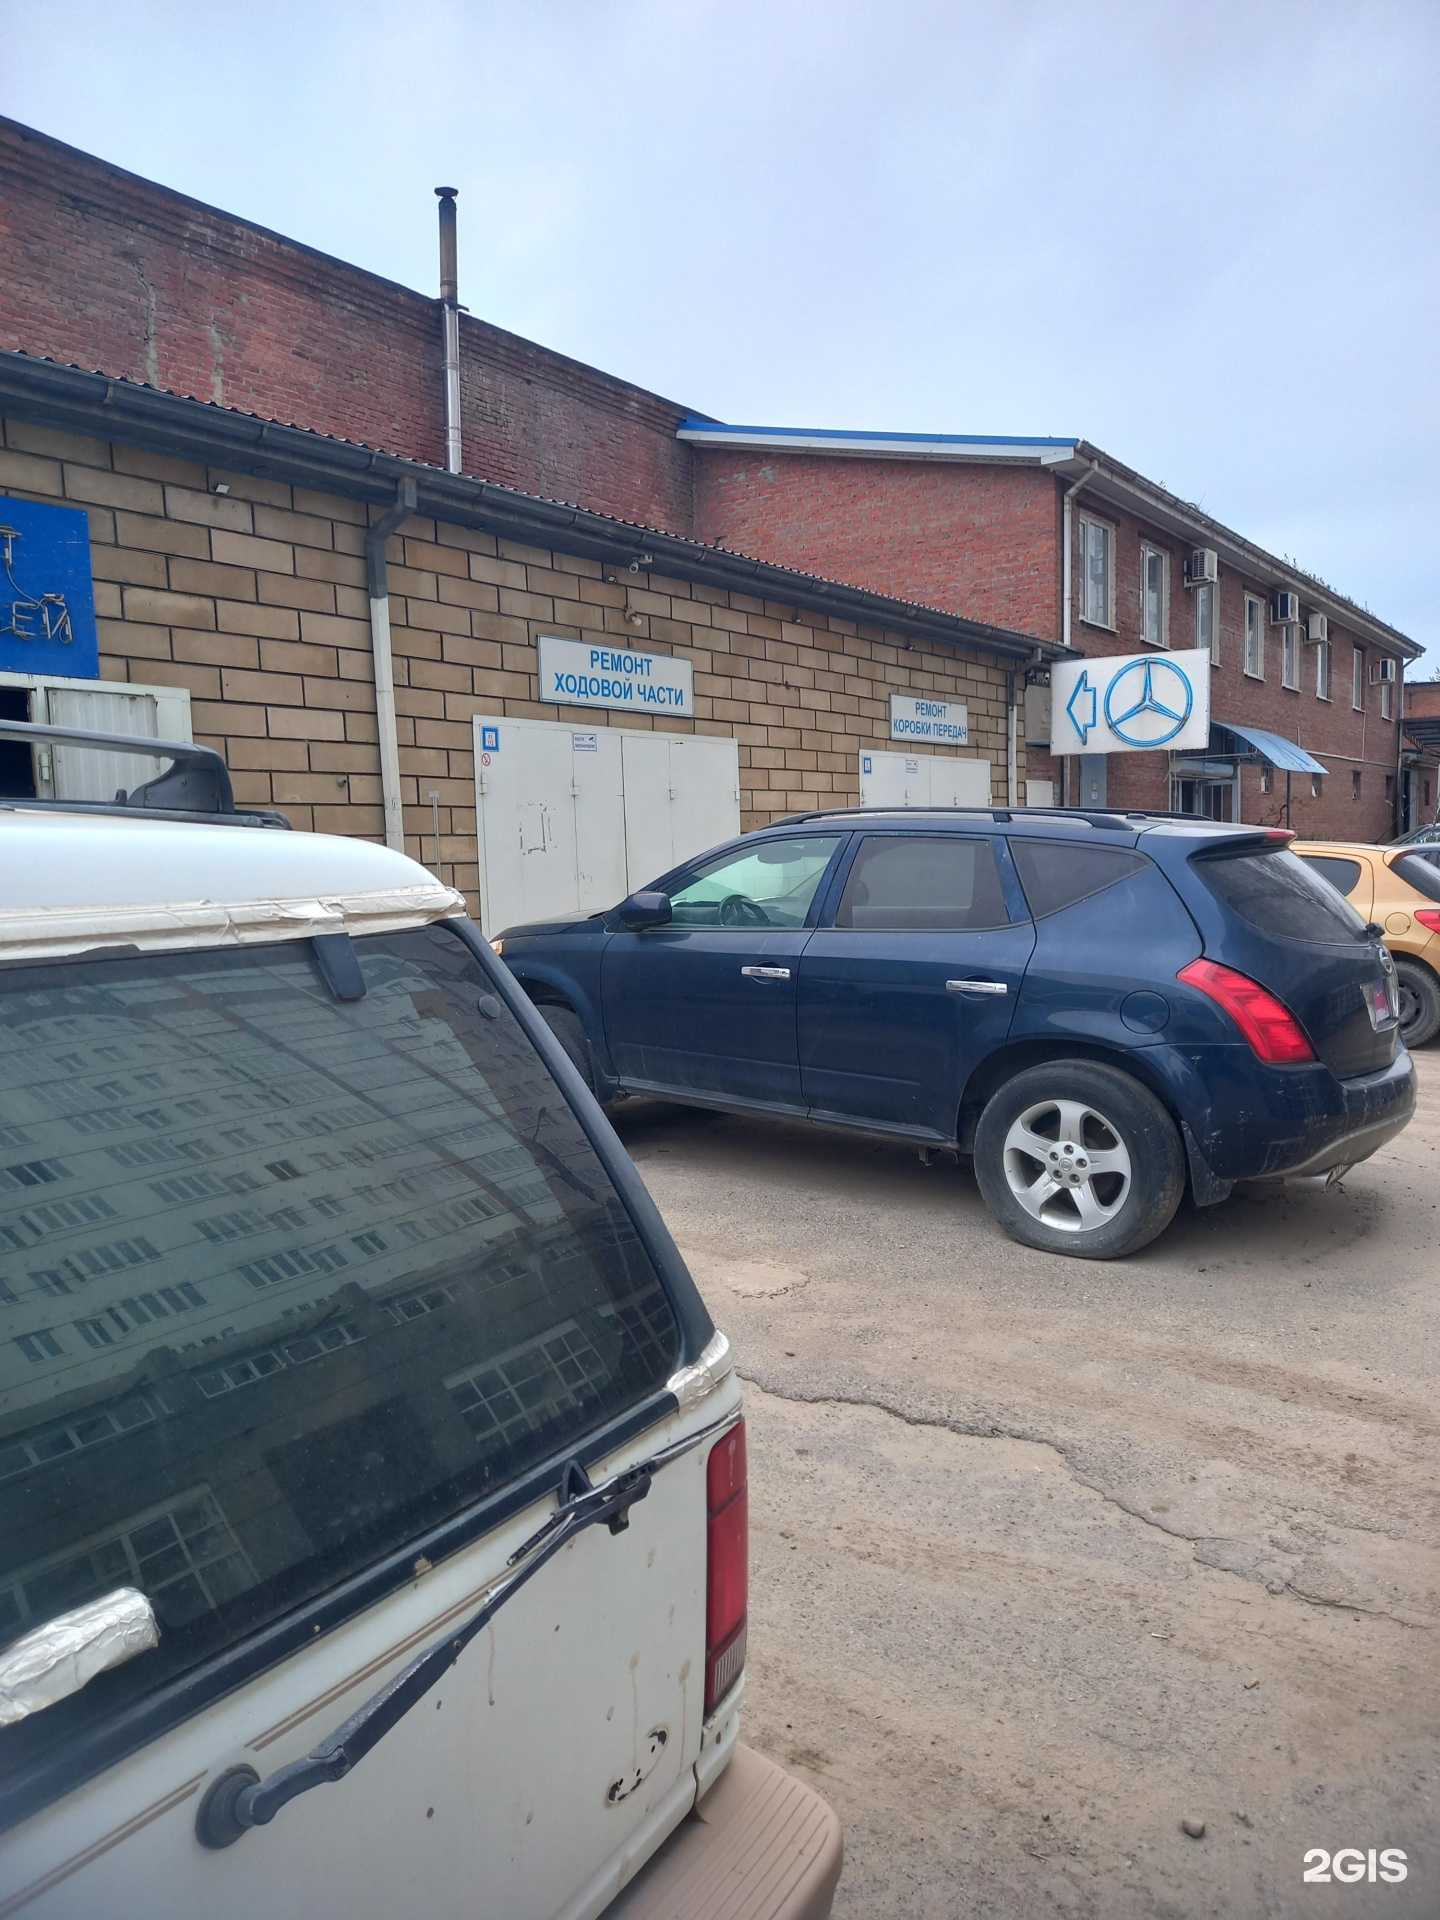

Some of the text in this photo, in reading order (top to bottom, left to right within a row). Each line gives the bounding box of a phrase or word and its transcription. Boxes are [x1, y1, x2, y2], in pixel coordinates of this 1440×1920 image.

[590, 649, 653, 677] РЕМОНТ
[554, 672, 684, 706] ХОДОВОЙ ЧАСТИ
[915, 701, 948, 719] РЕМОНТ
[893, 719, 967, 739] КОРОБКИ ПЕРЕДАЧ
